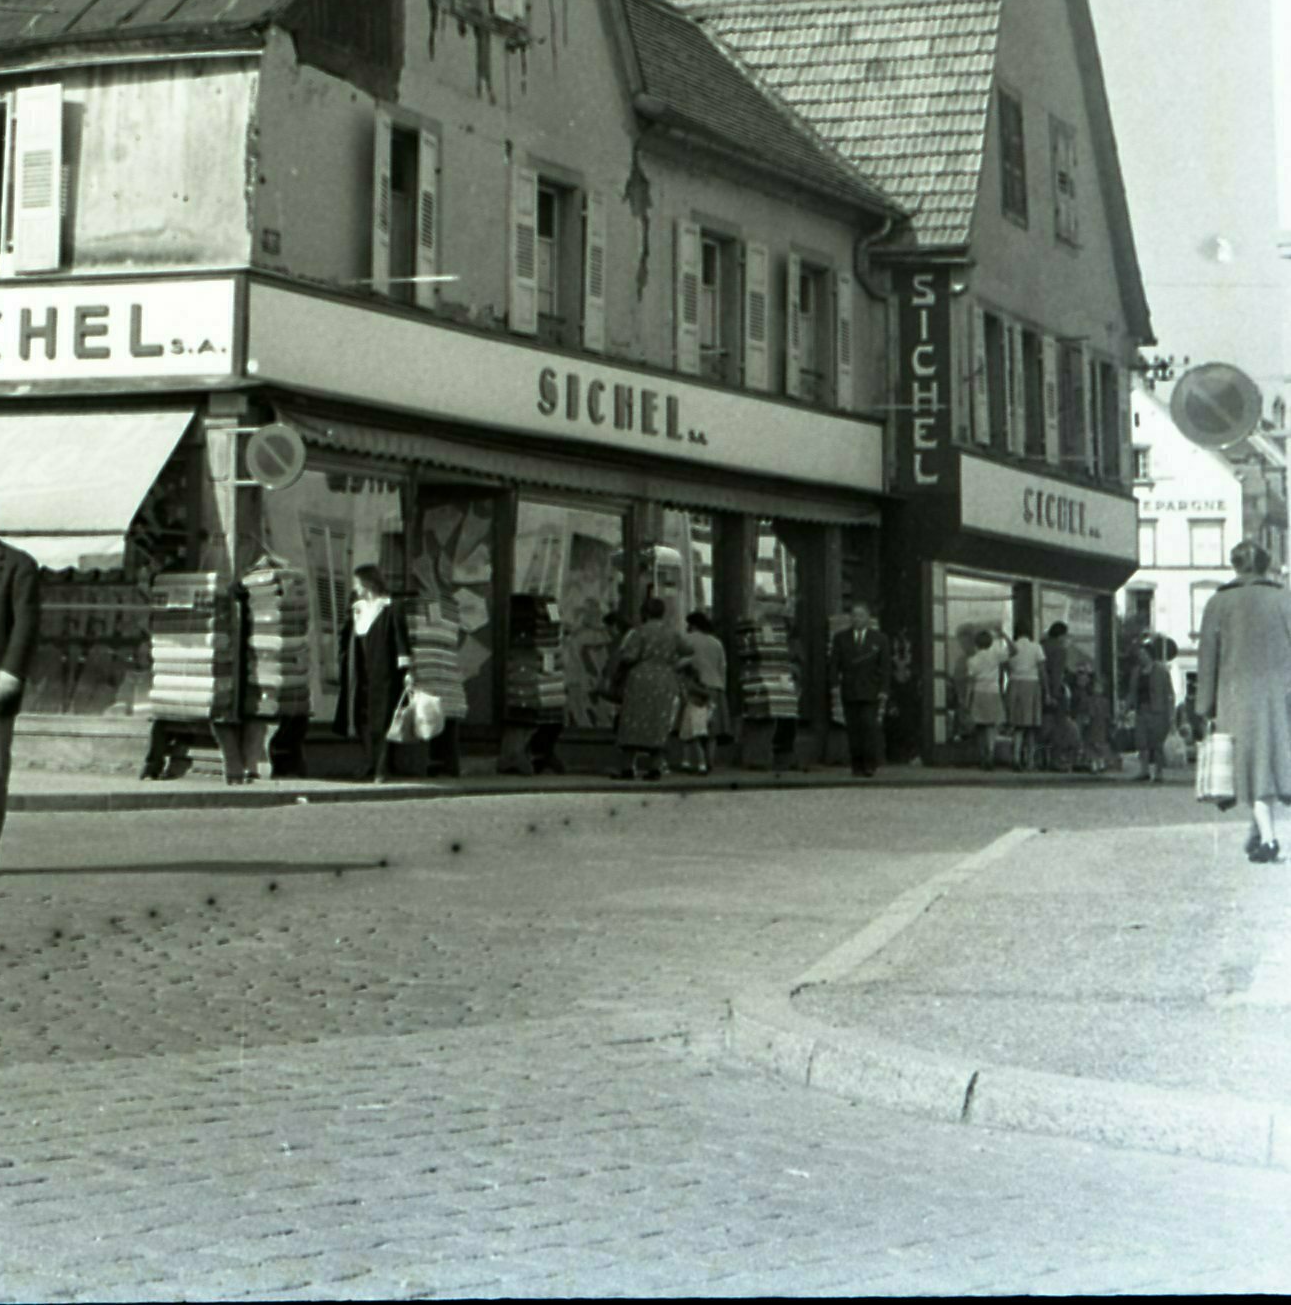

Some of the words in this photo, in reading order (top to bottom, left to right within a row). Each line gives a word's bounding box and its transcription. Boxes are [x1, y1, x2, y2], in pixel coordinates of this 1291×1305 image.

[170, 338, 227, 355] S.A.
[911, 274, 939, 485] SICHEL
[536, 366, 683, 442] SICHEL
